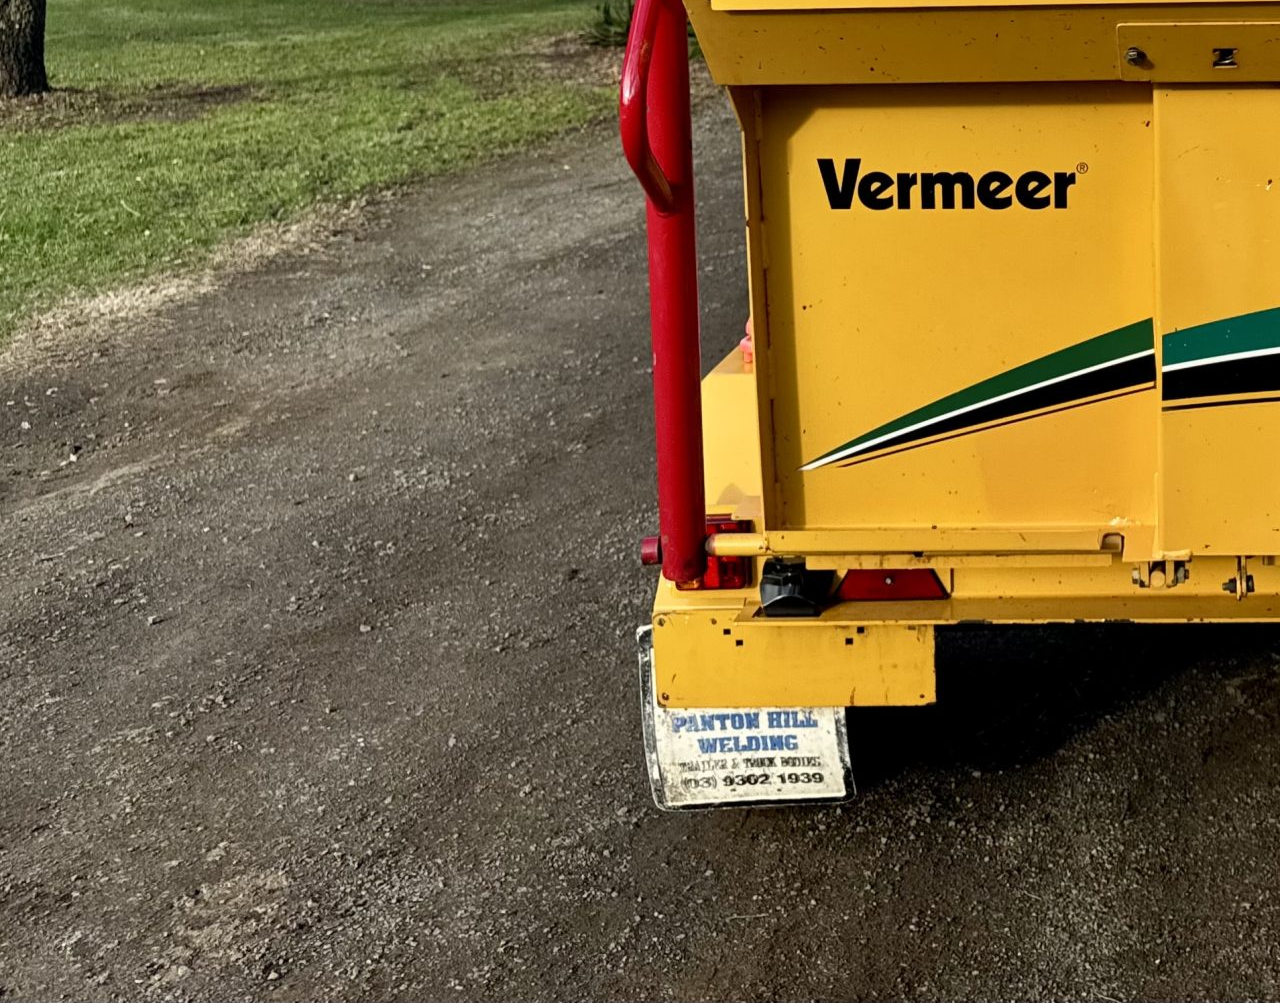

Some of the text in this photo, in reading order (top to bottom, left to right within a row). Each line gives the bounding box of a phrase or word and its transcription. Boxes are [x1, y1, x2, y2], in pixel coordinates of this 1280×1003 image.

[671, 710, 818, 733] PANTON HILL
[698, 734, 799, 754] WELDING
[681, 772, 825, 792] (03) 9302 1939
